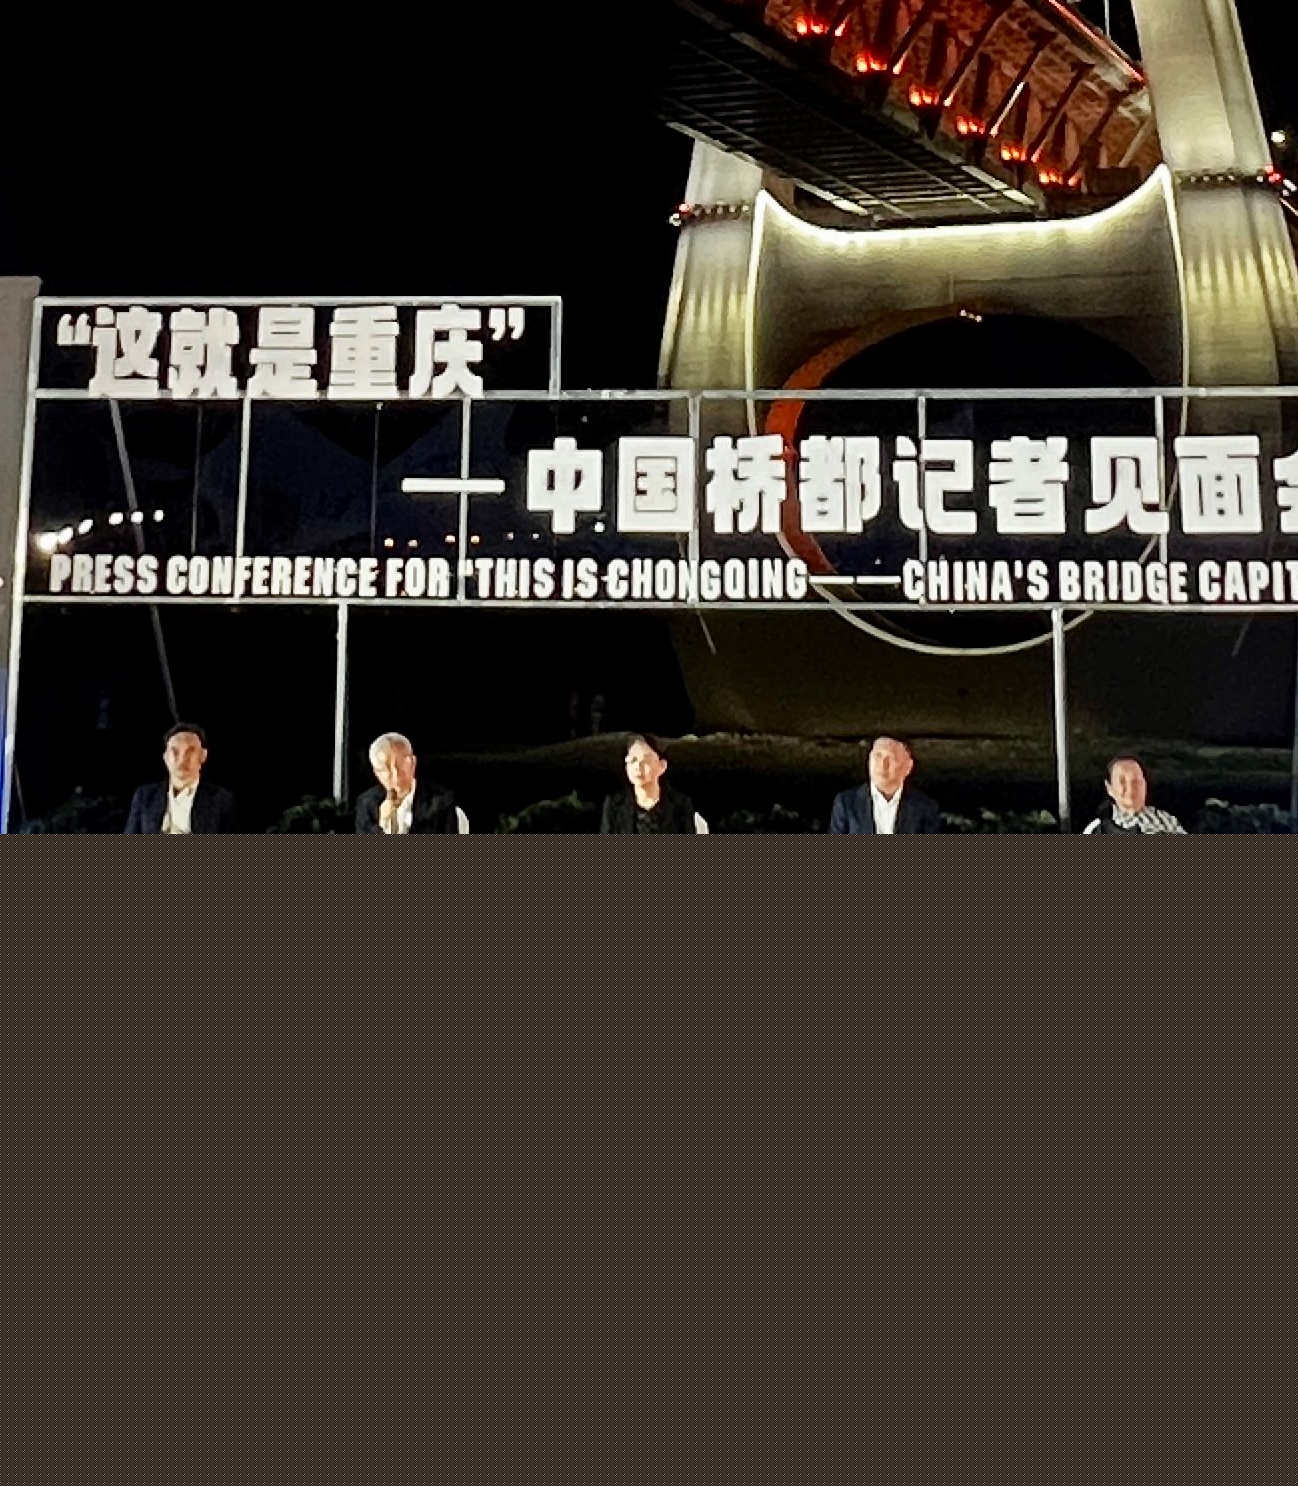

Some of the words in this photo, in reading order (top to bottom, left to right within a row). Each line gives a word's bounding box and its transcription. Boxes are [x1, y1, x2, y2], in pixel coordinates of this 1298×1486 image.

[56, 304, 525, 399] “这就是重庆”
[49, 554, 158, 594] PRESS
[166, 555, 379, 597] CONFERENCE
[385, 557, 451, 598] FOR
[561, 557, 599, 600] IS
[1059, 560, 1188, 602] BRIDGE
